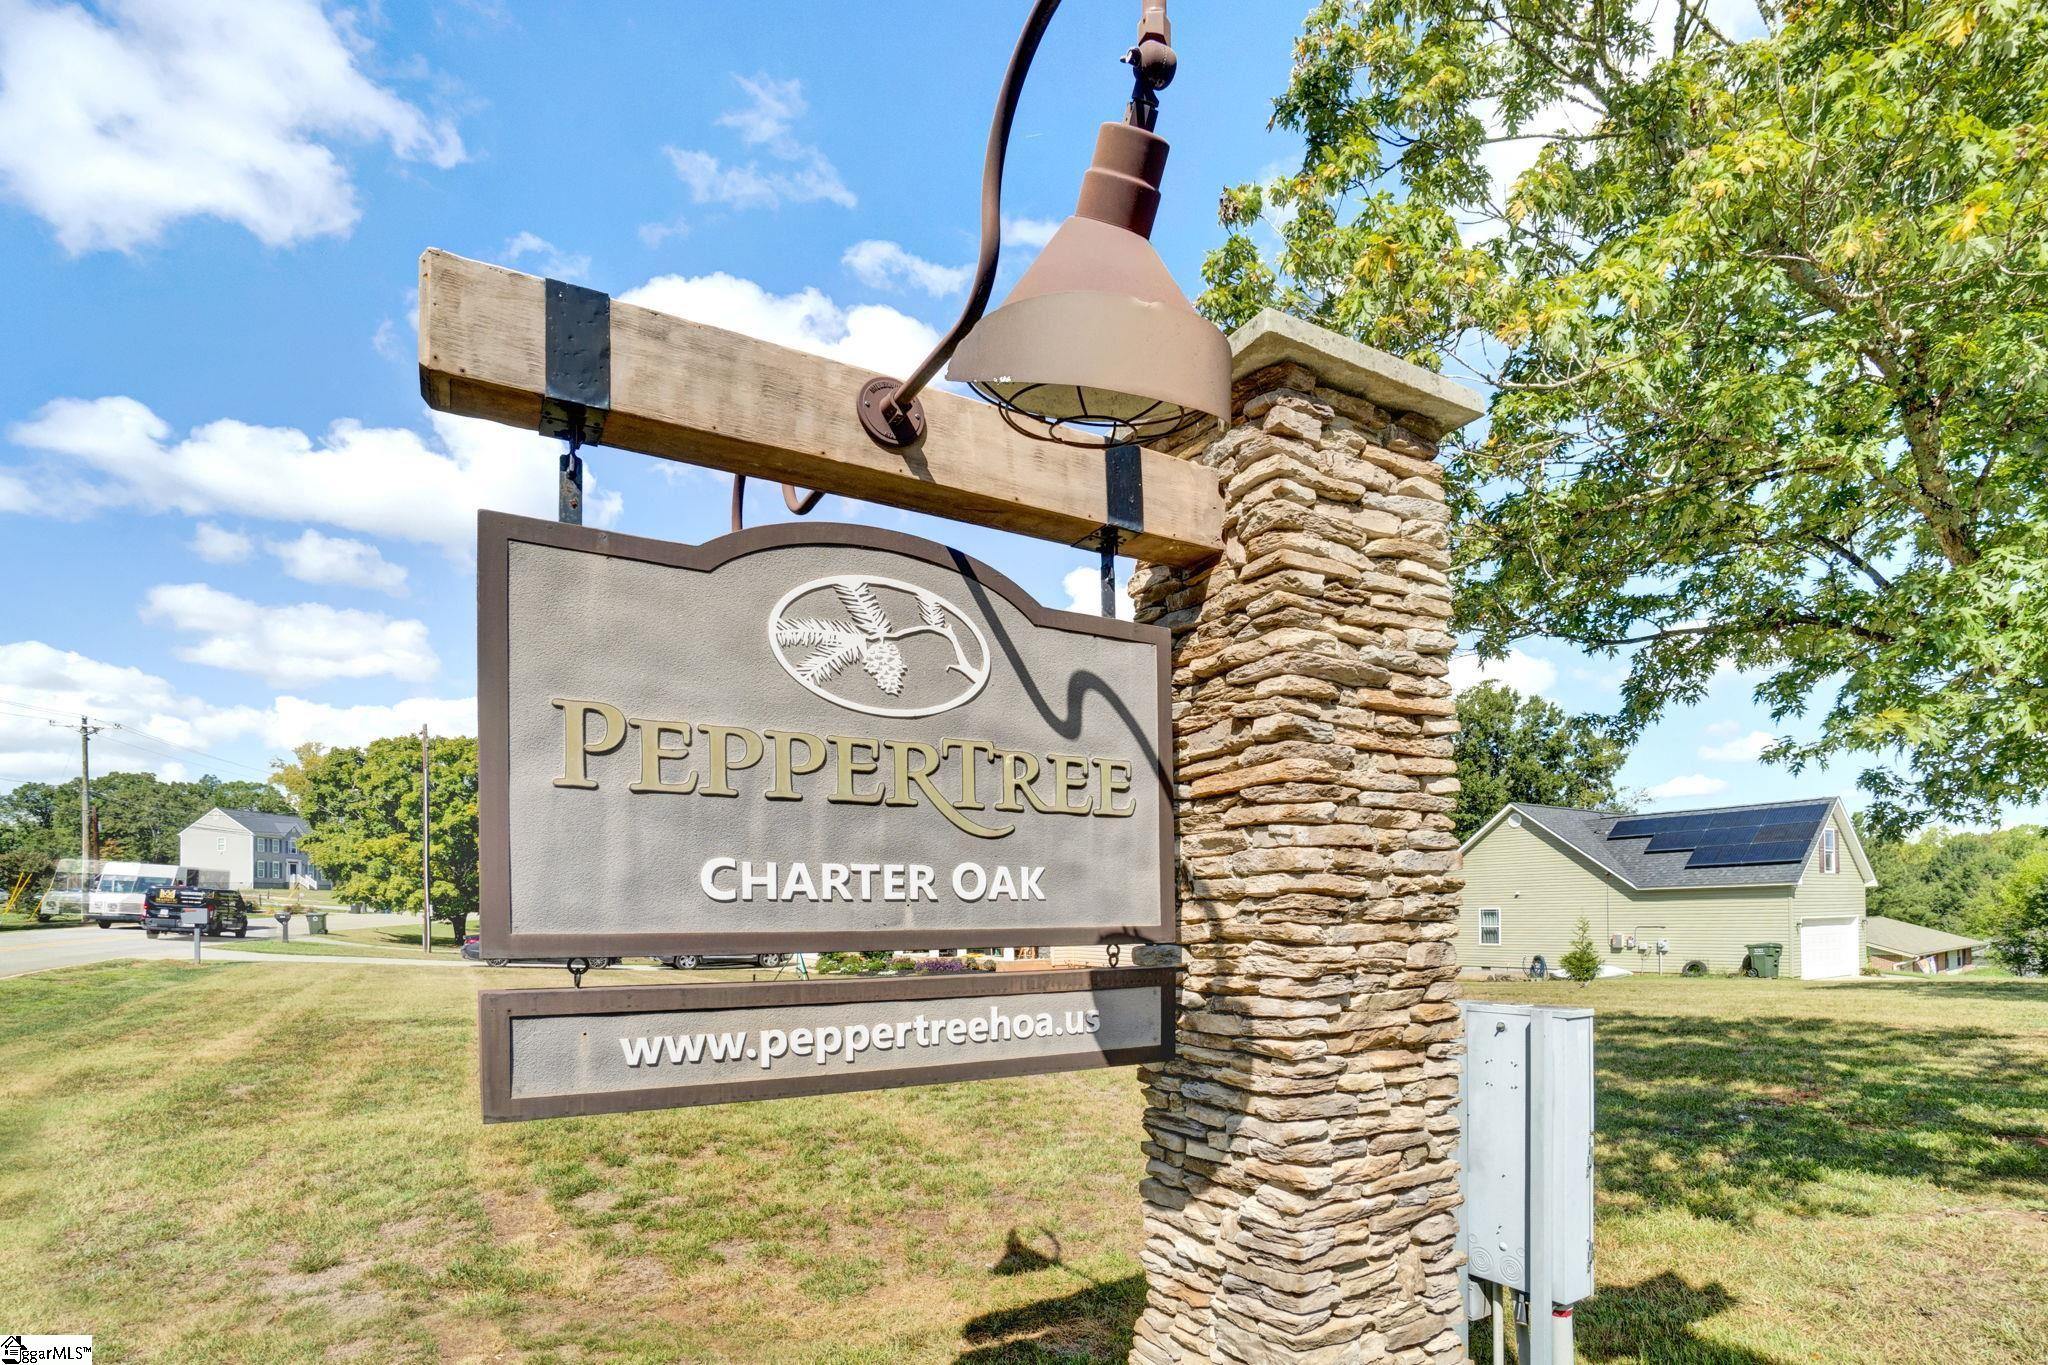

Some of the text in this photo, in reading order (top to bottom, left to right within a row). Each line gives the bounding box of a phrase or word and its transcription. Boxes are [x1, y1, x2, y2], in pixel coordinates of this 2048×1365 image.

[552, 698, 1137, 838] PEPPERTREE
[700, 857, 1046, 902] CHARTER OAK
[619, 1006, 1101, 1069] www.peppertreehoa.us
